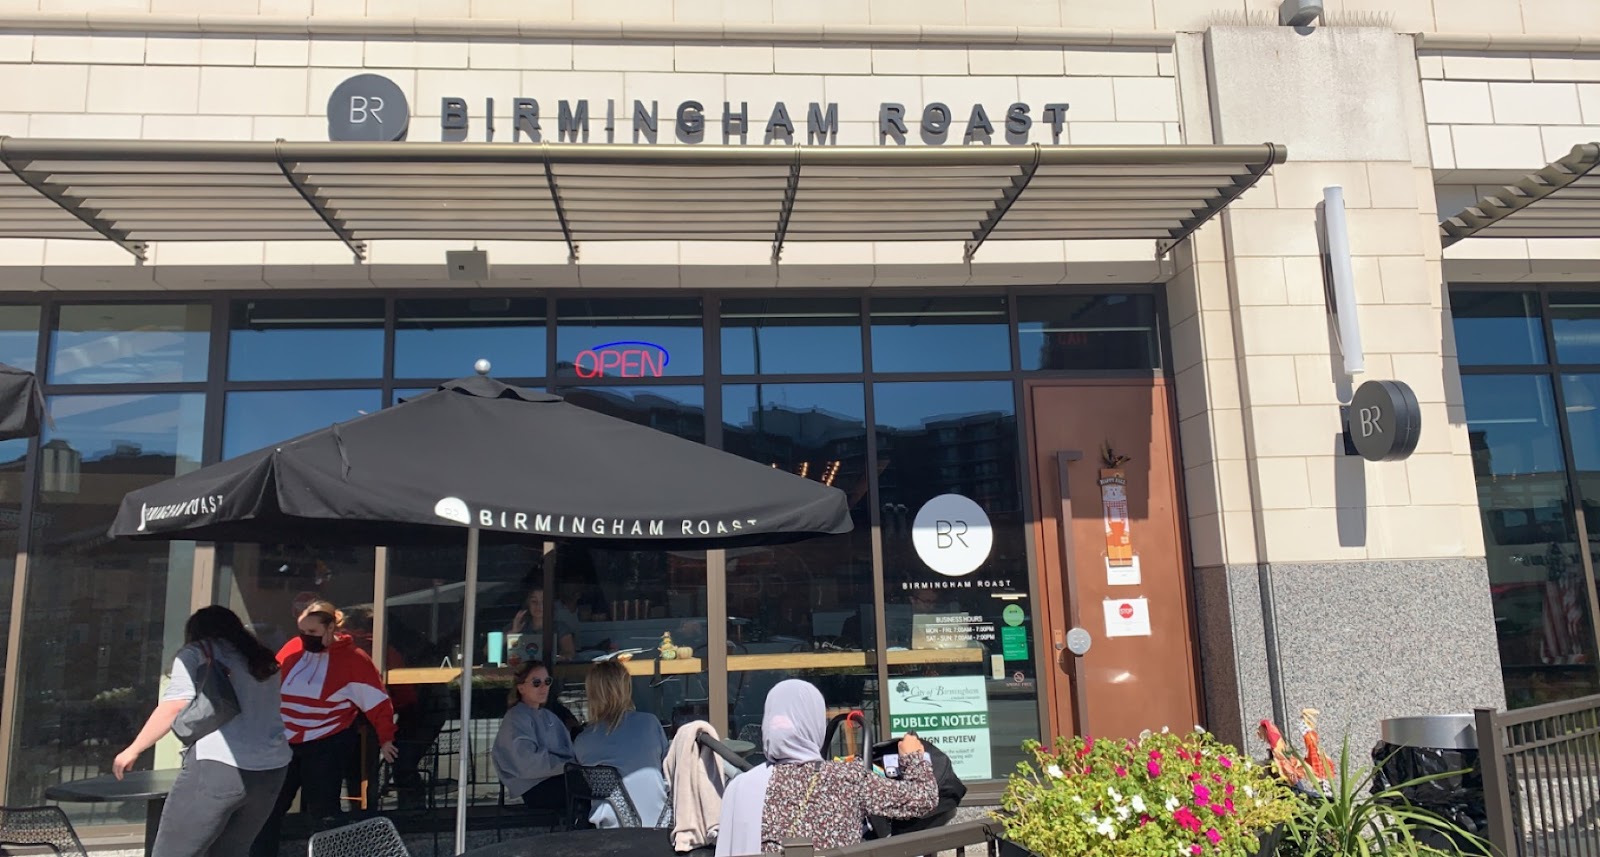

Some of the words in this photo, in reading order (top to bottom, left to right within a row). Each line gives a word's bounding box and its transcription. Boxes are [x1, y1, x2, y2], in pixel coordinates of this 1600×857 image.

[349, 95, 385, 125] BR
[440, 97, 839, 136] BIRMINGHAM
[879, 102, 1071, 136] ROAST
[574, 349, 664, 379] OPEN
[1359, 405, 1384, 438] BR
[479, 509, 664, 536] BIRMINGHAM
[935, 519, 970, 550] BR
[902, 580, 972, 591] BIRMINGHAM
[976, 579, 1012, 588] ROAST
[935, 615, 963, 624] BUSINESS
[963, 614, 983, 623] HOURS
[892, 715, 938, 729] PUBLIC
[941, 714, 988, 726] NOTICE
[942, 735, 977, 744] REVIEW
